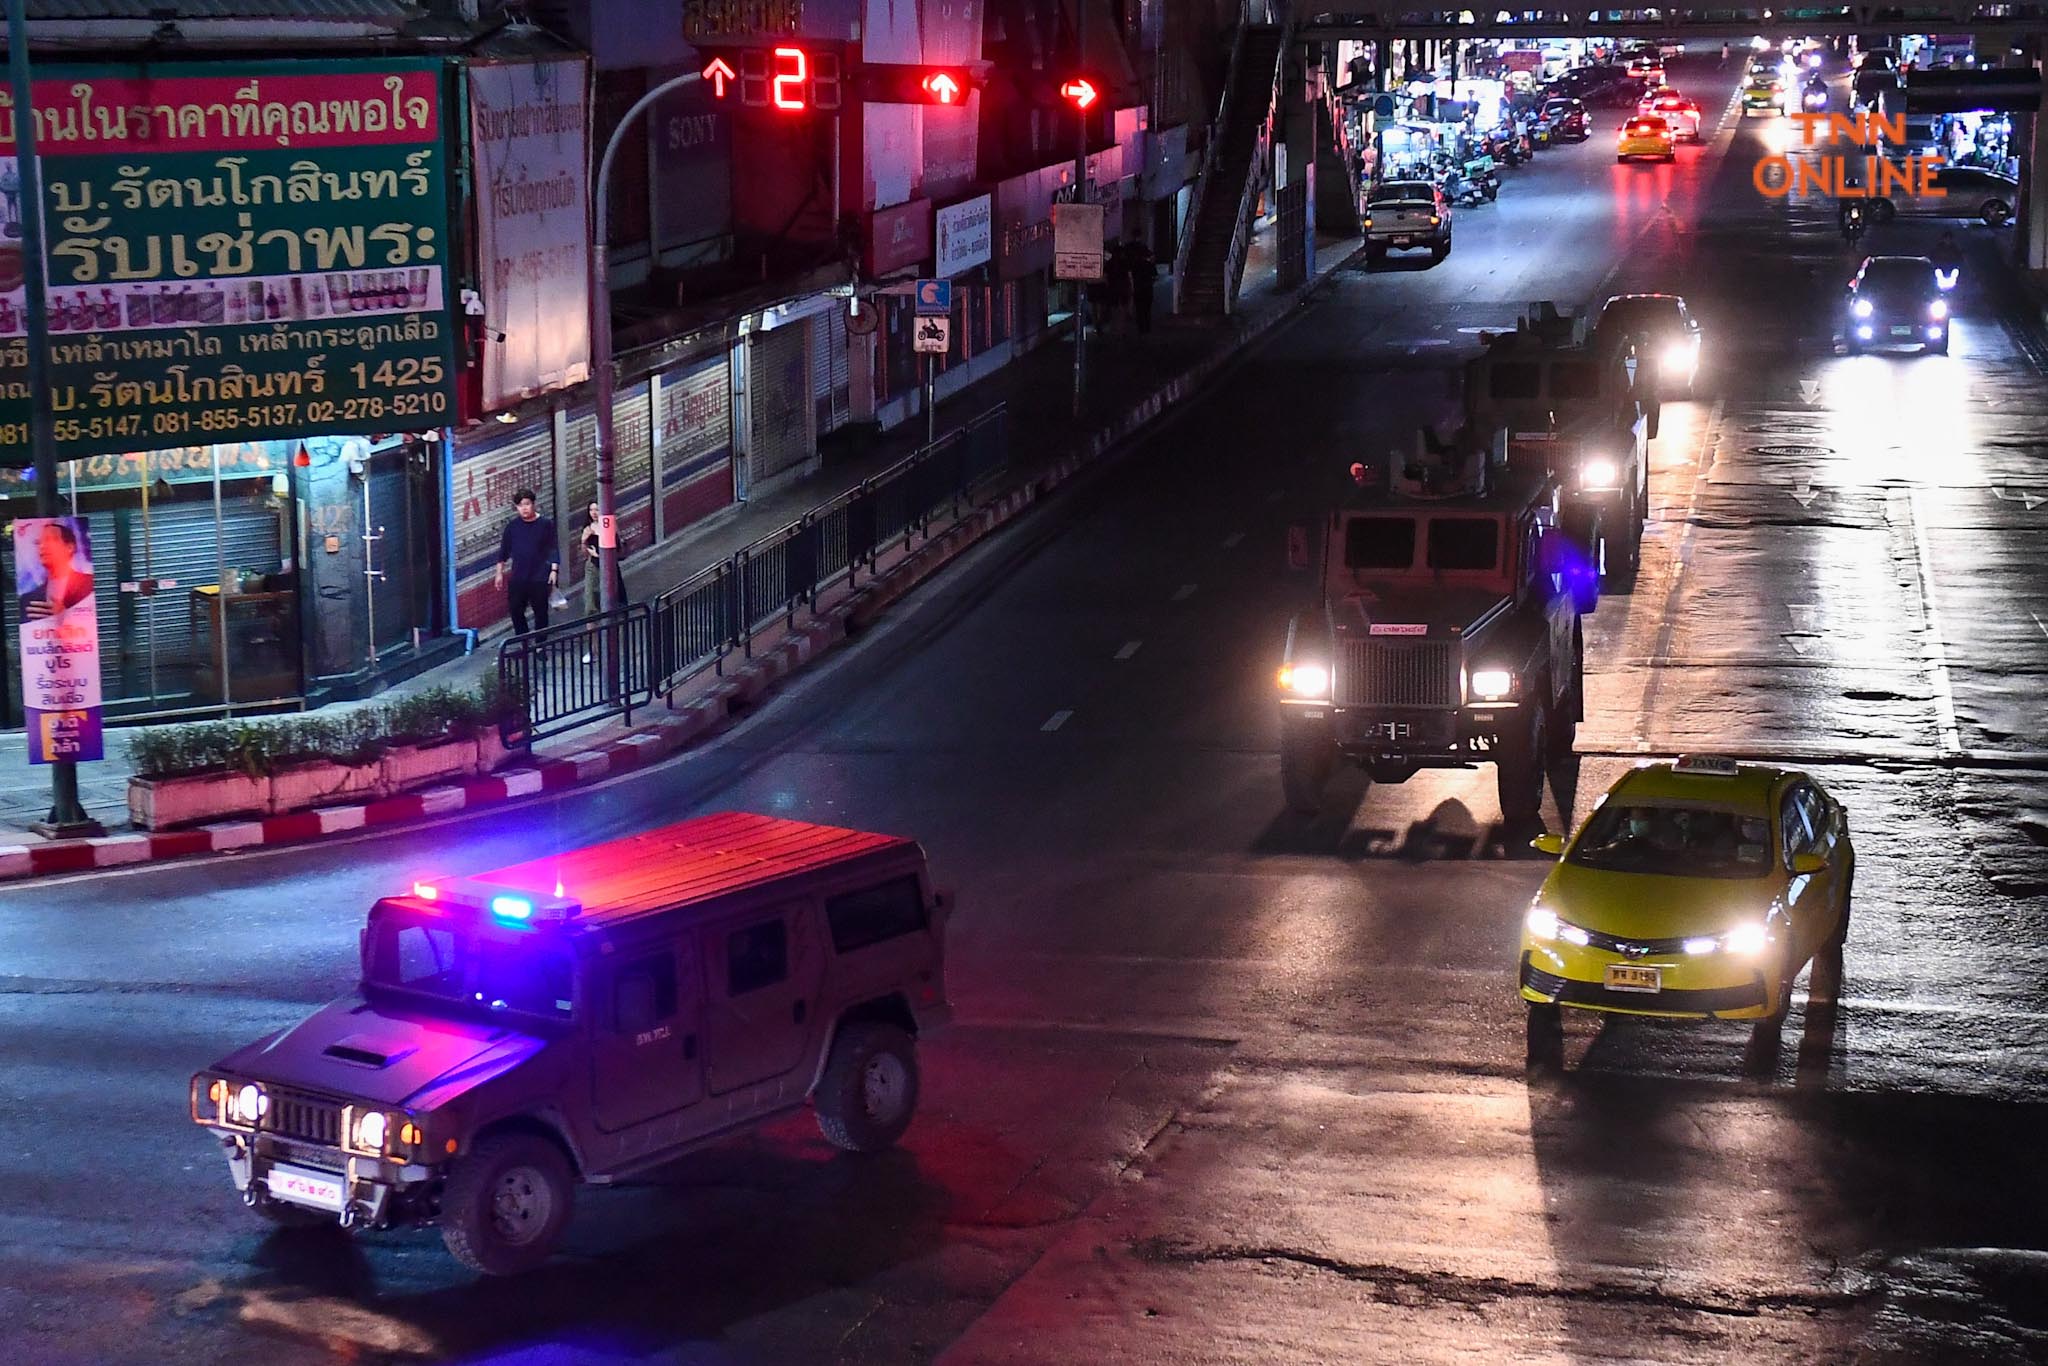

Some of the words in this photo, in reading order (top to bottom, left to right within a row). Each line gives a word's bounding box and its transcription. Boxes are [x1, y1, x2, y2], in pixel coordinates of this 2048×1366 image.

[774, 48, 808, 110] 2
[669, 113, 719, 150] SONY
[49, 149, 431, 213] บ.รัตนโกสินทร์
[51, 211, 436, 281] รับเช่าพระ
[239, 313, 439, 357] เหล้ากระดูกเสือ
[350, 358, 443, 389] 1425
[307, 392, 446, 424] 02-278-5210
[603, 517, 610, 528] 8
